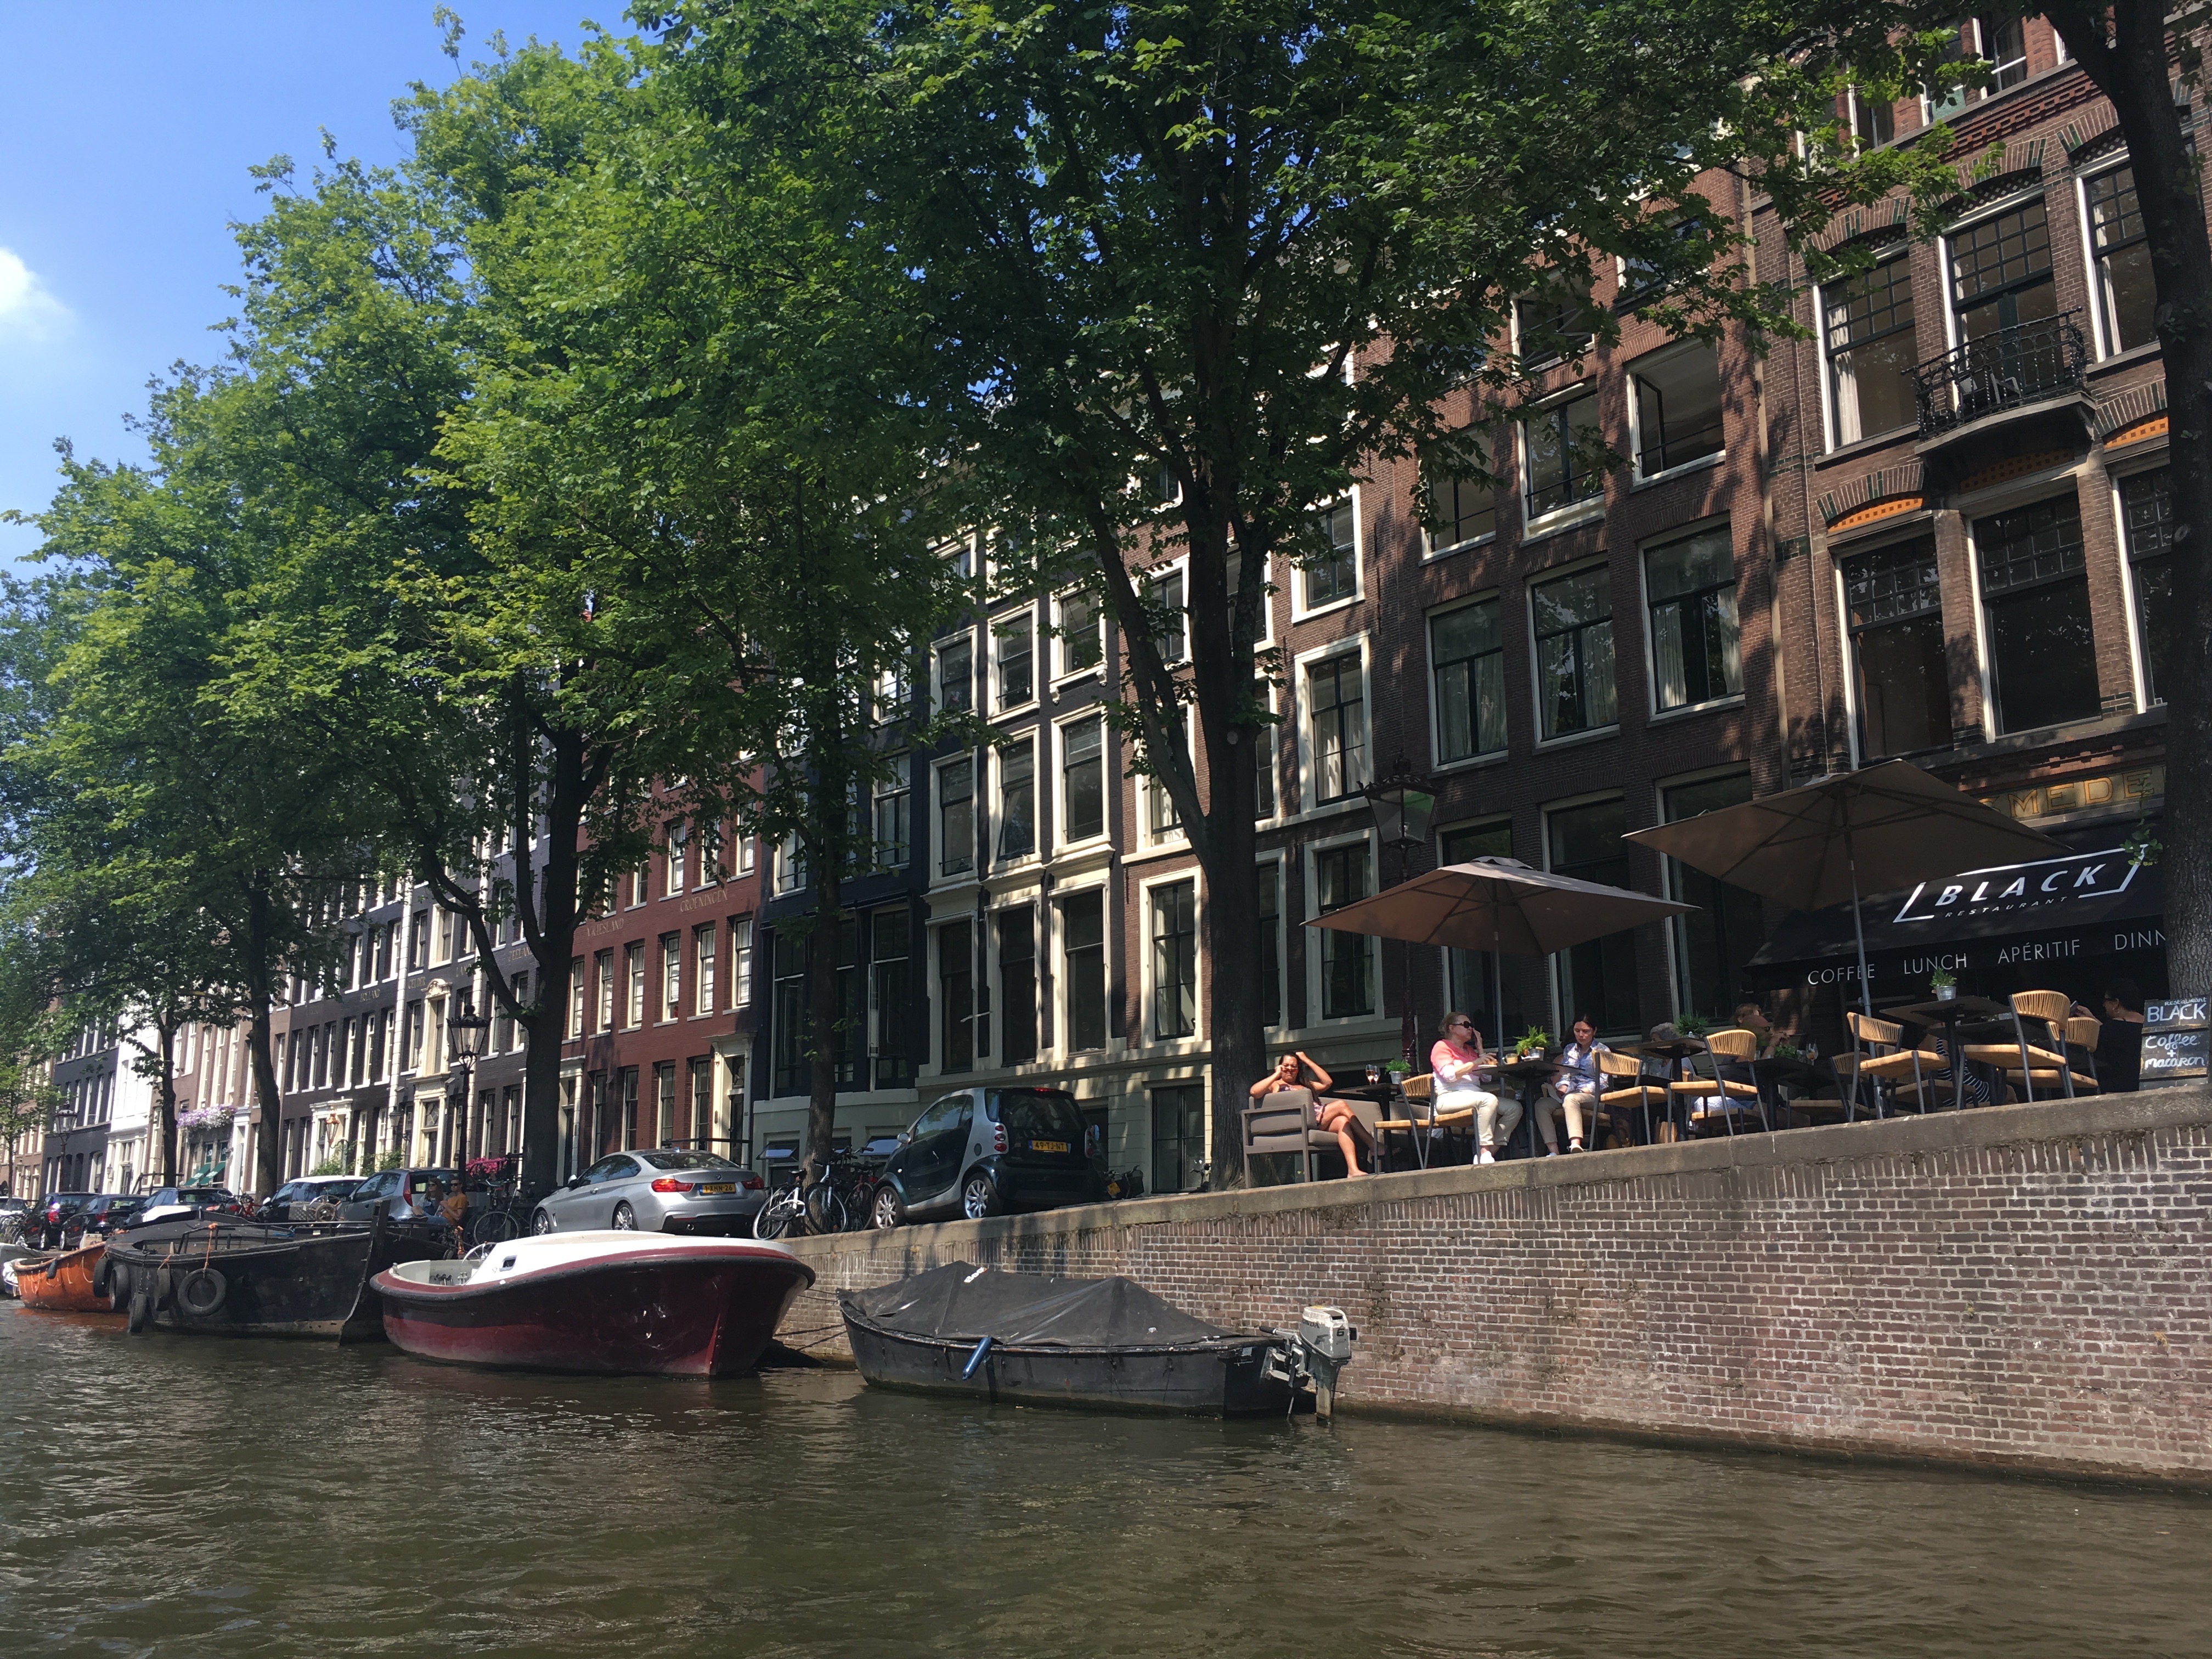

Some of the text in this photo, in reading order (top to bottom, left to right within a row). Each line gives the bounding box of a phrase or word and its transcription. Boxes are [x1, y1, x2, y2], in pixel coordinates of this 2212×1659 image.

[1935, 864, 2106, 906] BLACK
[1945, 896, 2067, 917] RESTAURANT
[1808, 963, 1875, 985] COFFEE
[1904, 953, 1967, 974] LUNCH
[1997, 939, 2080, 964] APÉRITIF
[2147, 1003, 2207, 1022] BLACK
[1336, 1328, 1345, 1337] 6
